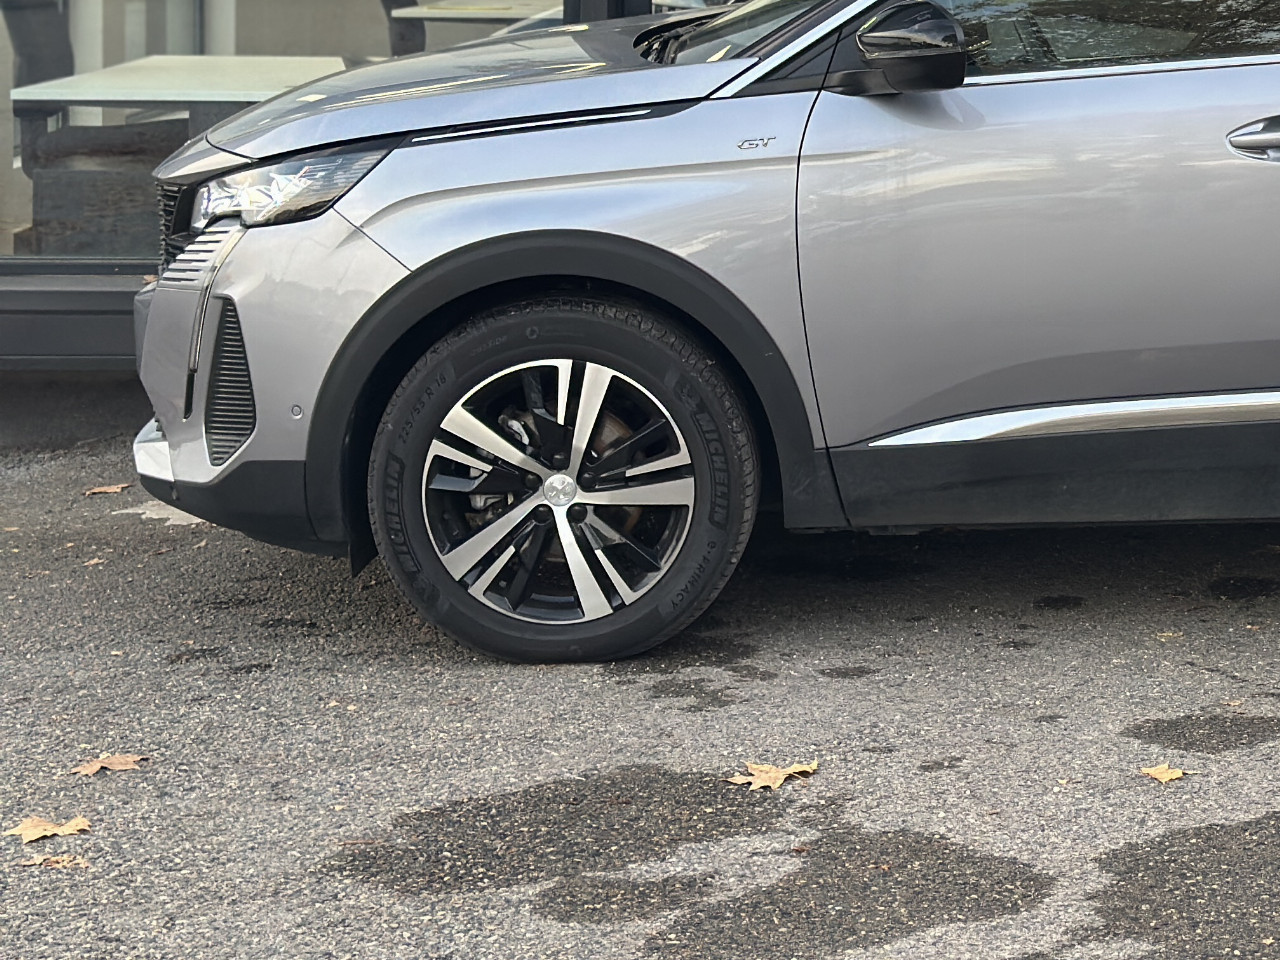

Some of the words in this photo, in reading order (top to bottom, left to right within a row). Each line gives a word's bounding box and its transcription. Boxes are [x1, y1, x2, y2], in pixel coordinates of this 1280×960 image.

[737, 136, 776, 150] GT
[384, 460, 420, 573] MICHELIN
[693, 411, 729, 523] MICHELIN
